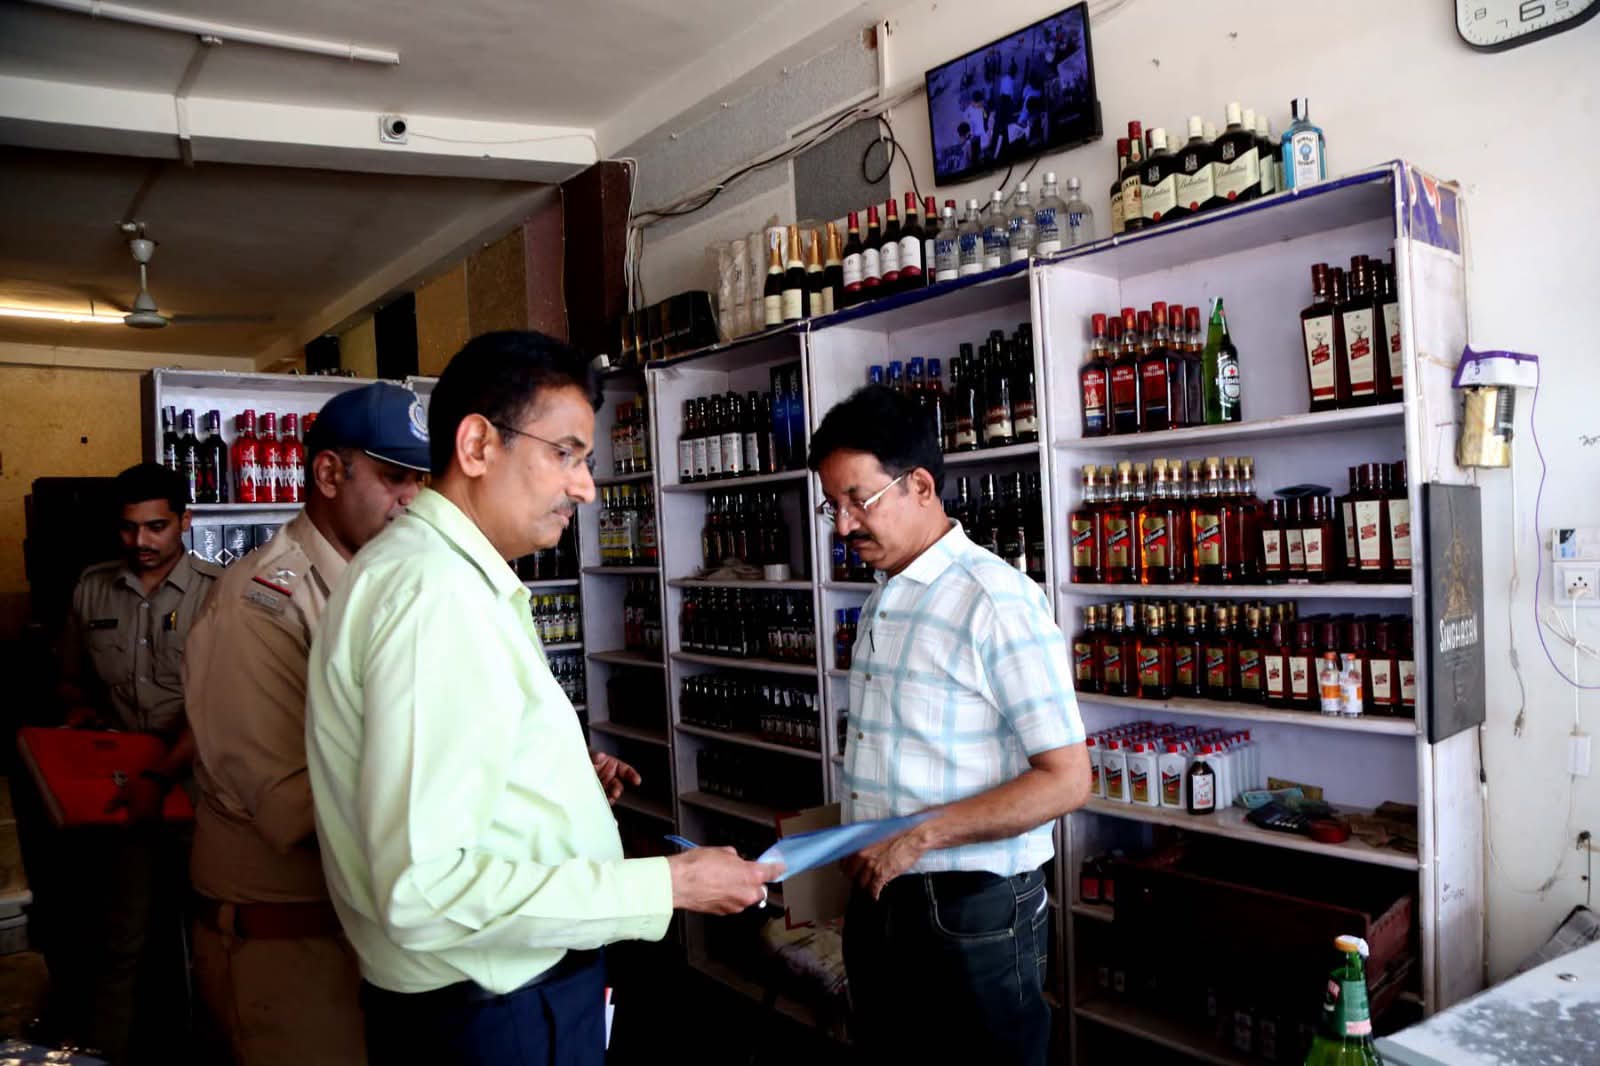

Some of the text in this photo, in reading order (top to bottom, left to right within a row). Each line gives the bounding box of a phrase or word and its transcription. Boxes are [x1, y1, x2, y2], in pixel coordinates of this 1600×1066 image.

[1474, 8, 1487, 21] 8
[1519, 0, 1545, 22] 6
[1440, 612, 1478, 653] SINGHASAN
